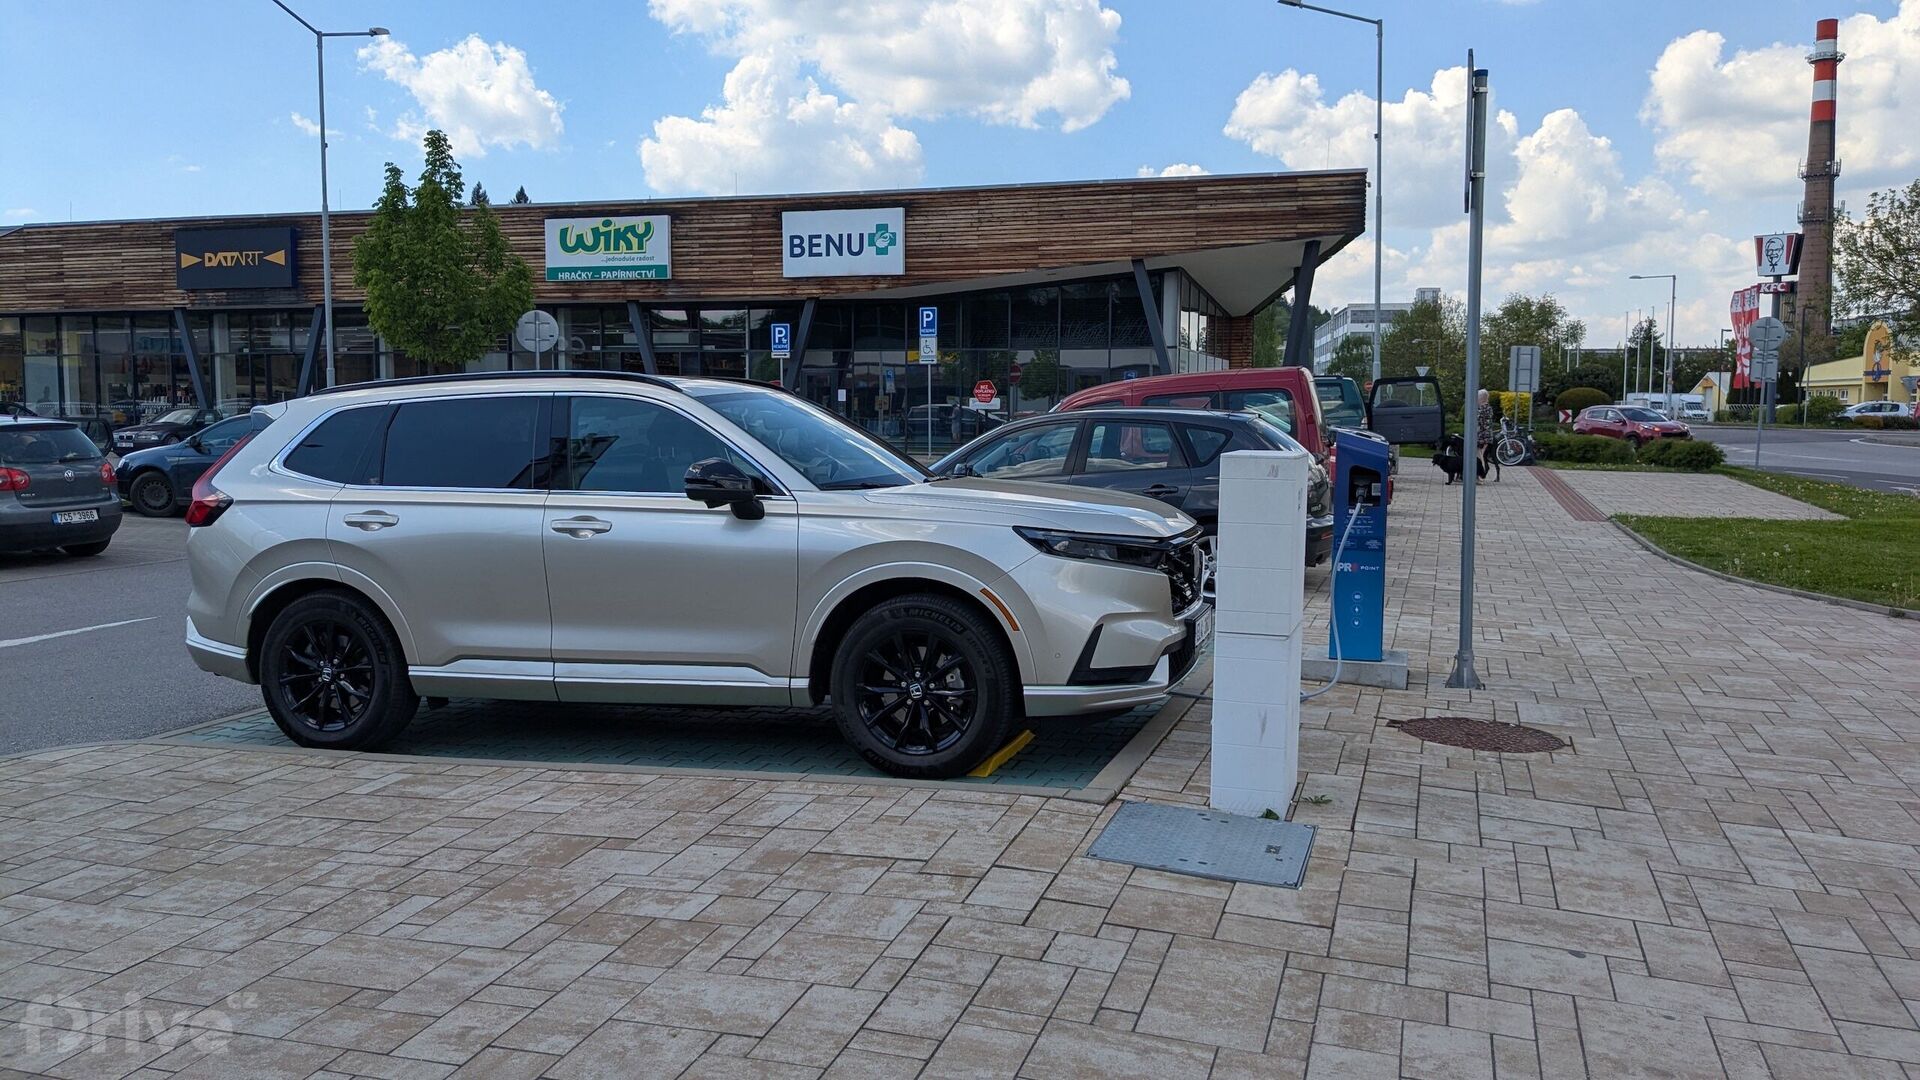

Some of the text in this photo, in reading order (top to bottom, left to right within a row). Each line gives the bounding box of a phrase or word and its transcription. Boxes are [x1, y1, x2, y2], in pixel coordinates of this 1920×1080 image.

[789, 232, 864, 258] BENU
[204, 251, 264, 267] DATART
[558, 270, 593, 280] HRAČKY
[601, 269, 656, 279] PAPÍRNICTVÍ
[1760, 282, 1786, 293] KFC
[923, 311, 934, 327] P
[775, 327, 786, 343] P
[59, 511, 95, 522] 7C5 3966
[908, 608, 965, 634] MICHELIN
